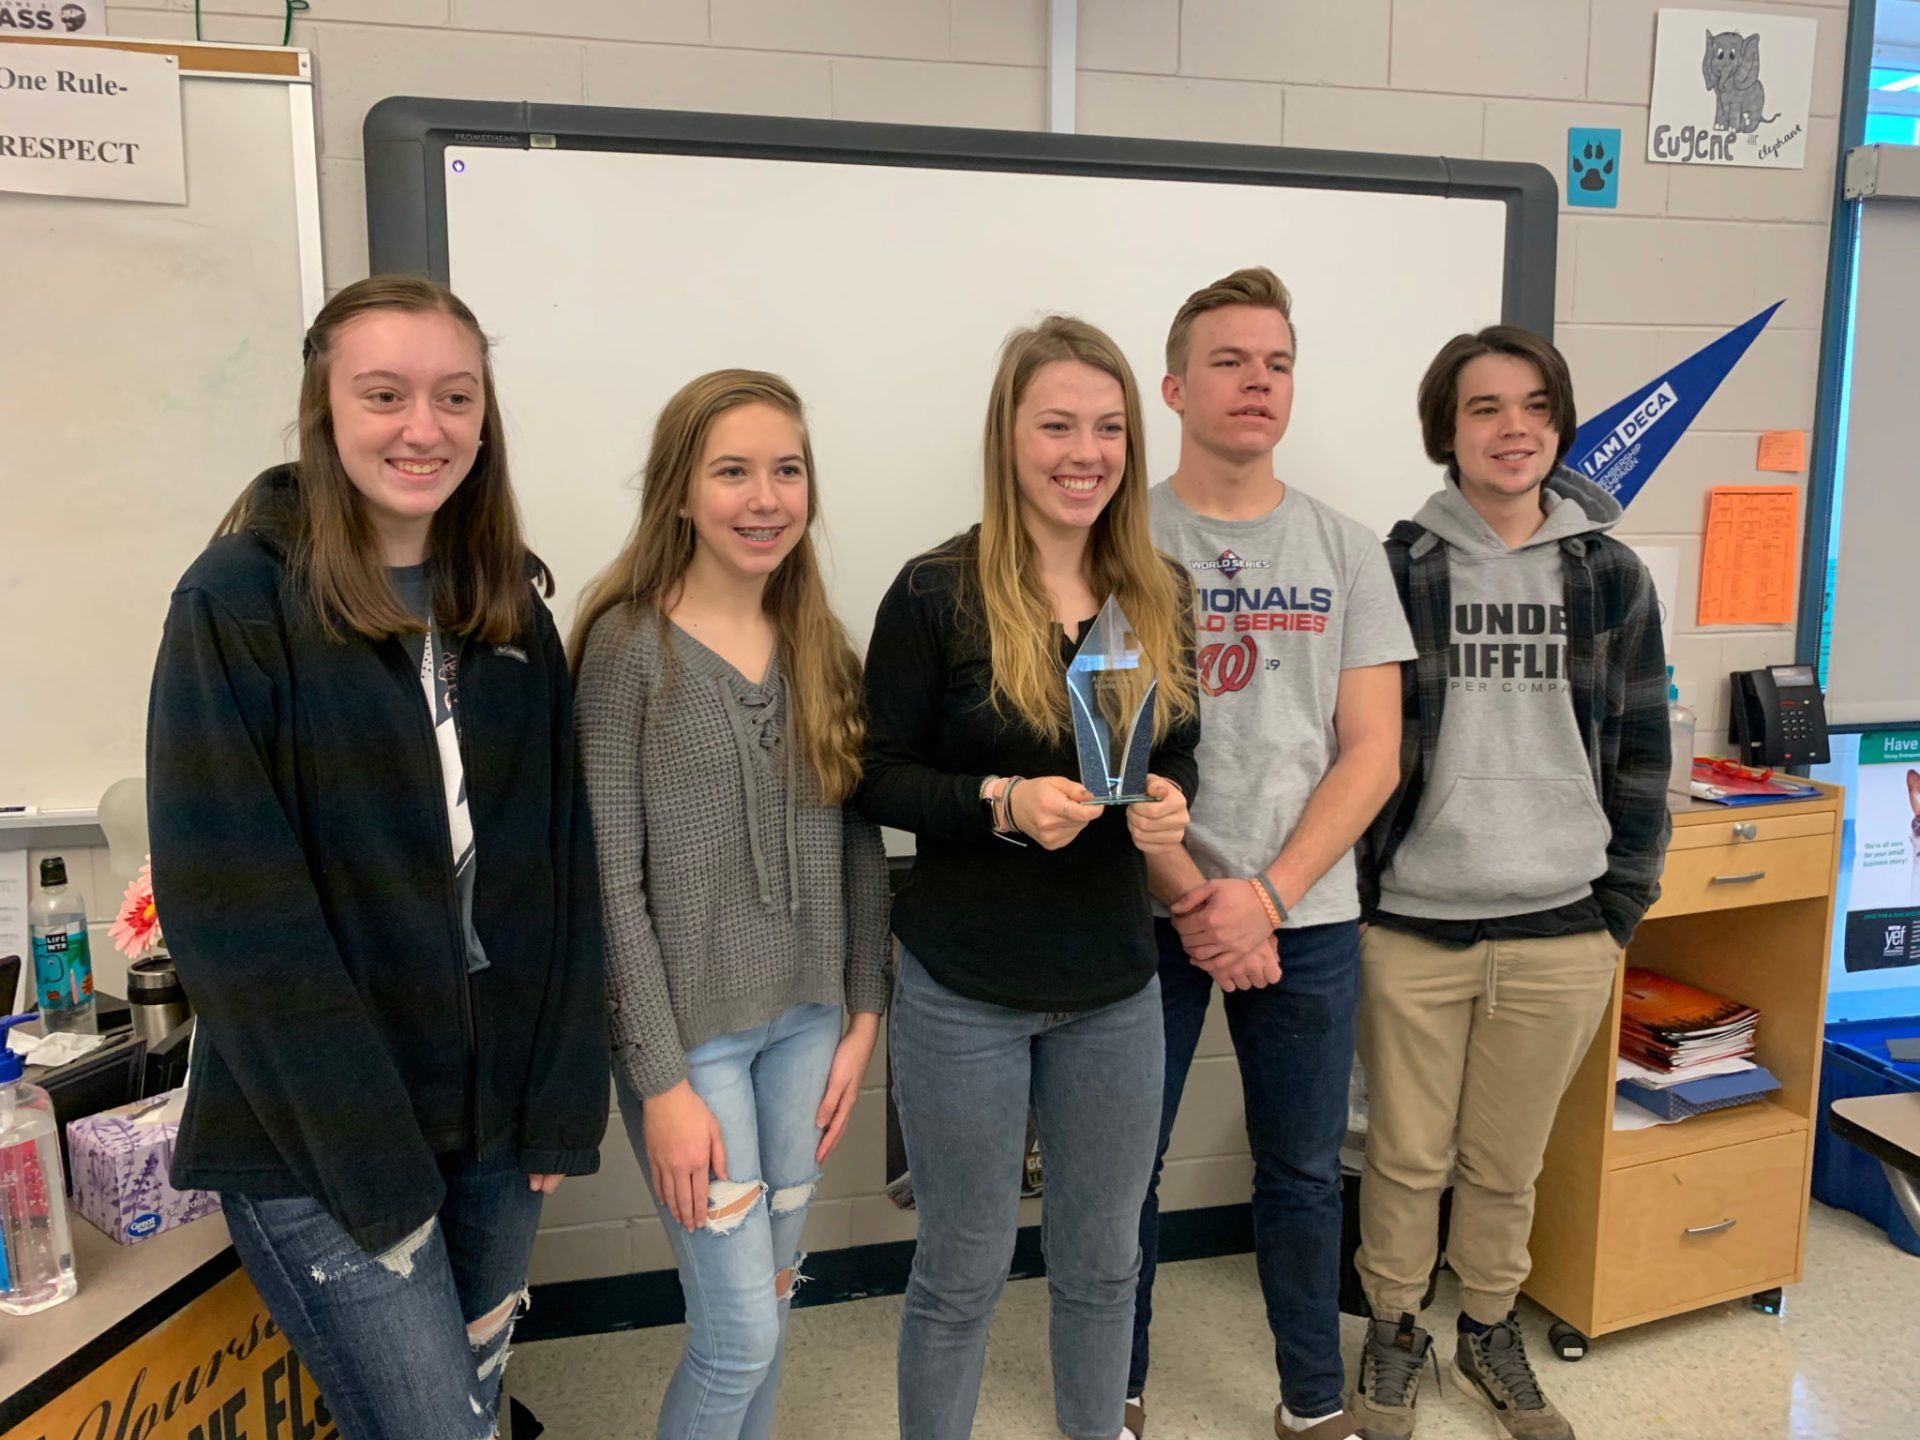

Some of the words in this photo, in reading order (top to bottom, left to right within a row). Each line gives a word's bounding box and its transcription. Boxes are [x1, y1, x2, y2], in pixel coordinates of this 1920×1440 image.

[0, 66, 47, 91] One
[56, 70, 128, 96] Rule-
[0, 135, 140, 165] RESPECT
[1653, 124, 1738, 162] Eugene
[1593, 436, 1621, 469] AM
[1622, 392, 1671, 438] DECA
[1597, 443, 1641, 488] EMBERSHIP
[1605, 456, 1639, 490] AMPAIGN
[1191, 559, 1230, 569] WORLD
[1232, 559, 1270, 568] SERIES
[1194, 586, 1332, 613] IONALS
[1234, 613, 1327, 633] SERIES
[1449, 643, 1568, 679] IFFLI
[1451, 682, 1488, 692] PER
[1883, 737, 1919, 751] Have
[1884, 925, 1906, 950] yef
